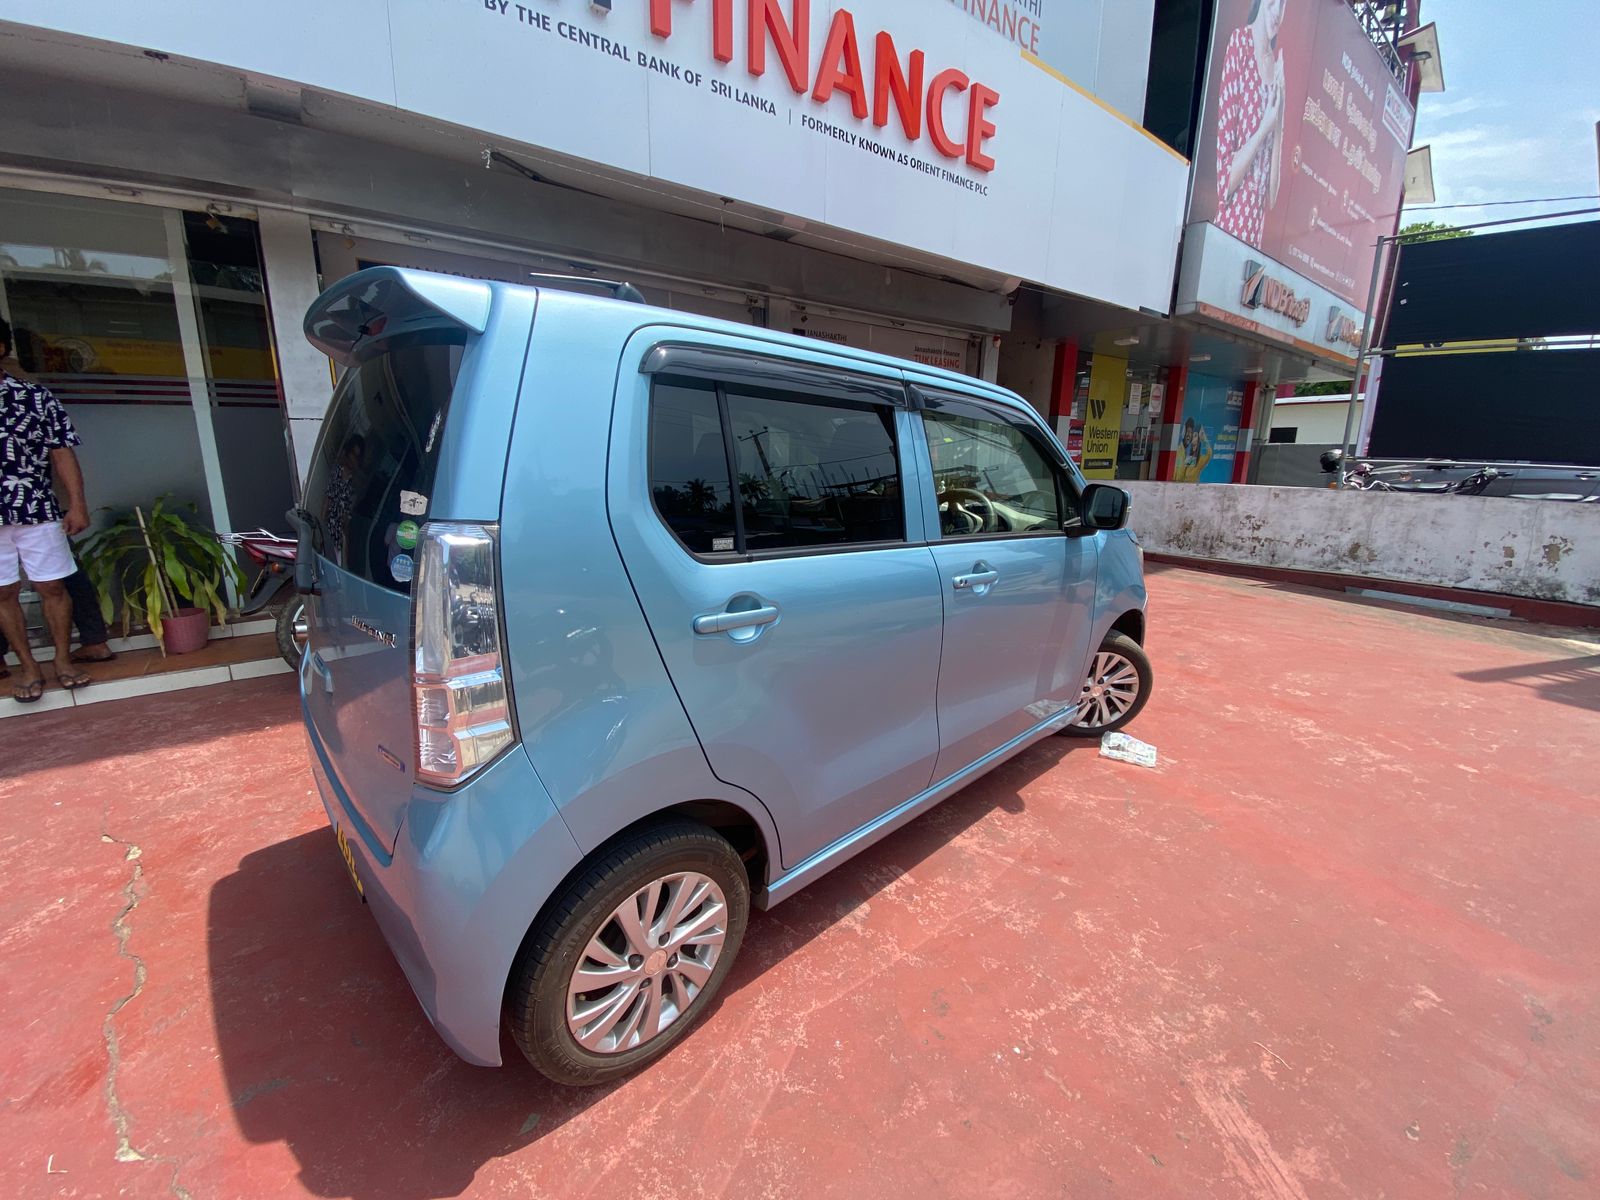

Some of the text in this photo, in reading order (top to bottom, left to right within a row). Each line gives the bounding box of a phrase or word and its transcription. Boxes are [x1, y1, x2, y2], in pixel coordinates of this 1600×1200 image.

[650, 0, 1001, 172] INANCE
[484, 0, 988, 197] BY THE CENTRAL BANK OF SRI LANKA FORMERLY KNOWN AS ORIENT FINANCE PLC
[930, 356, 960, 369] LEASING
[1089, 425, 1119, 440] Western
[1086, 440, 1109, 453] Union
